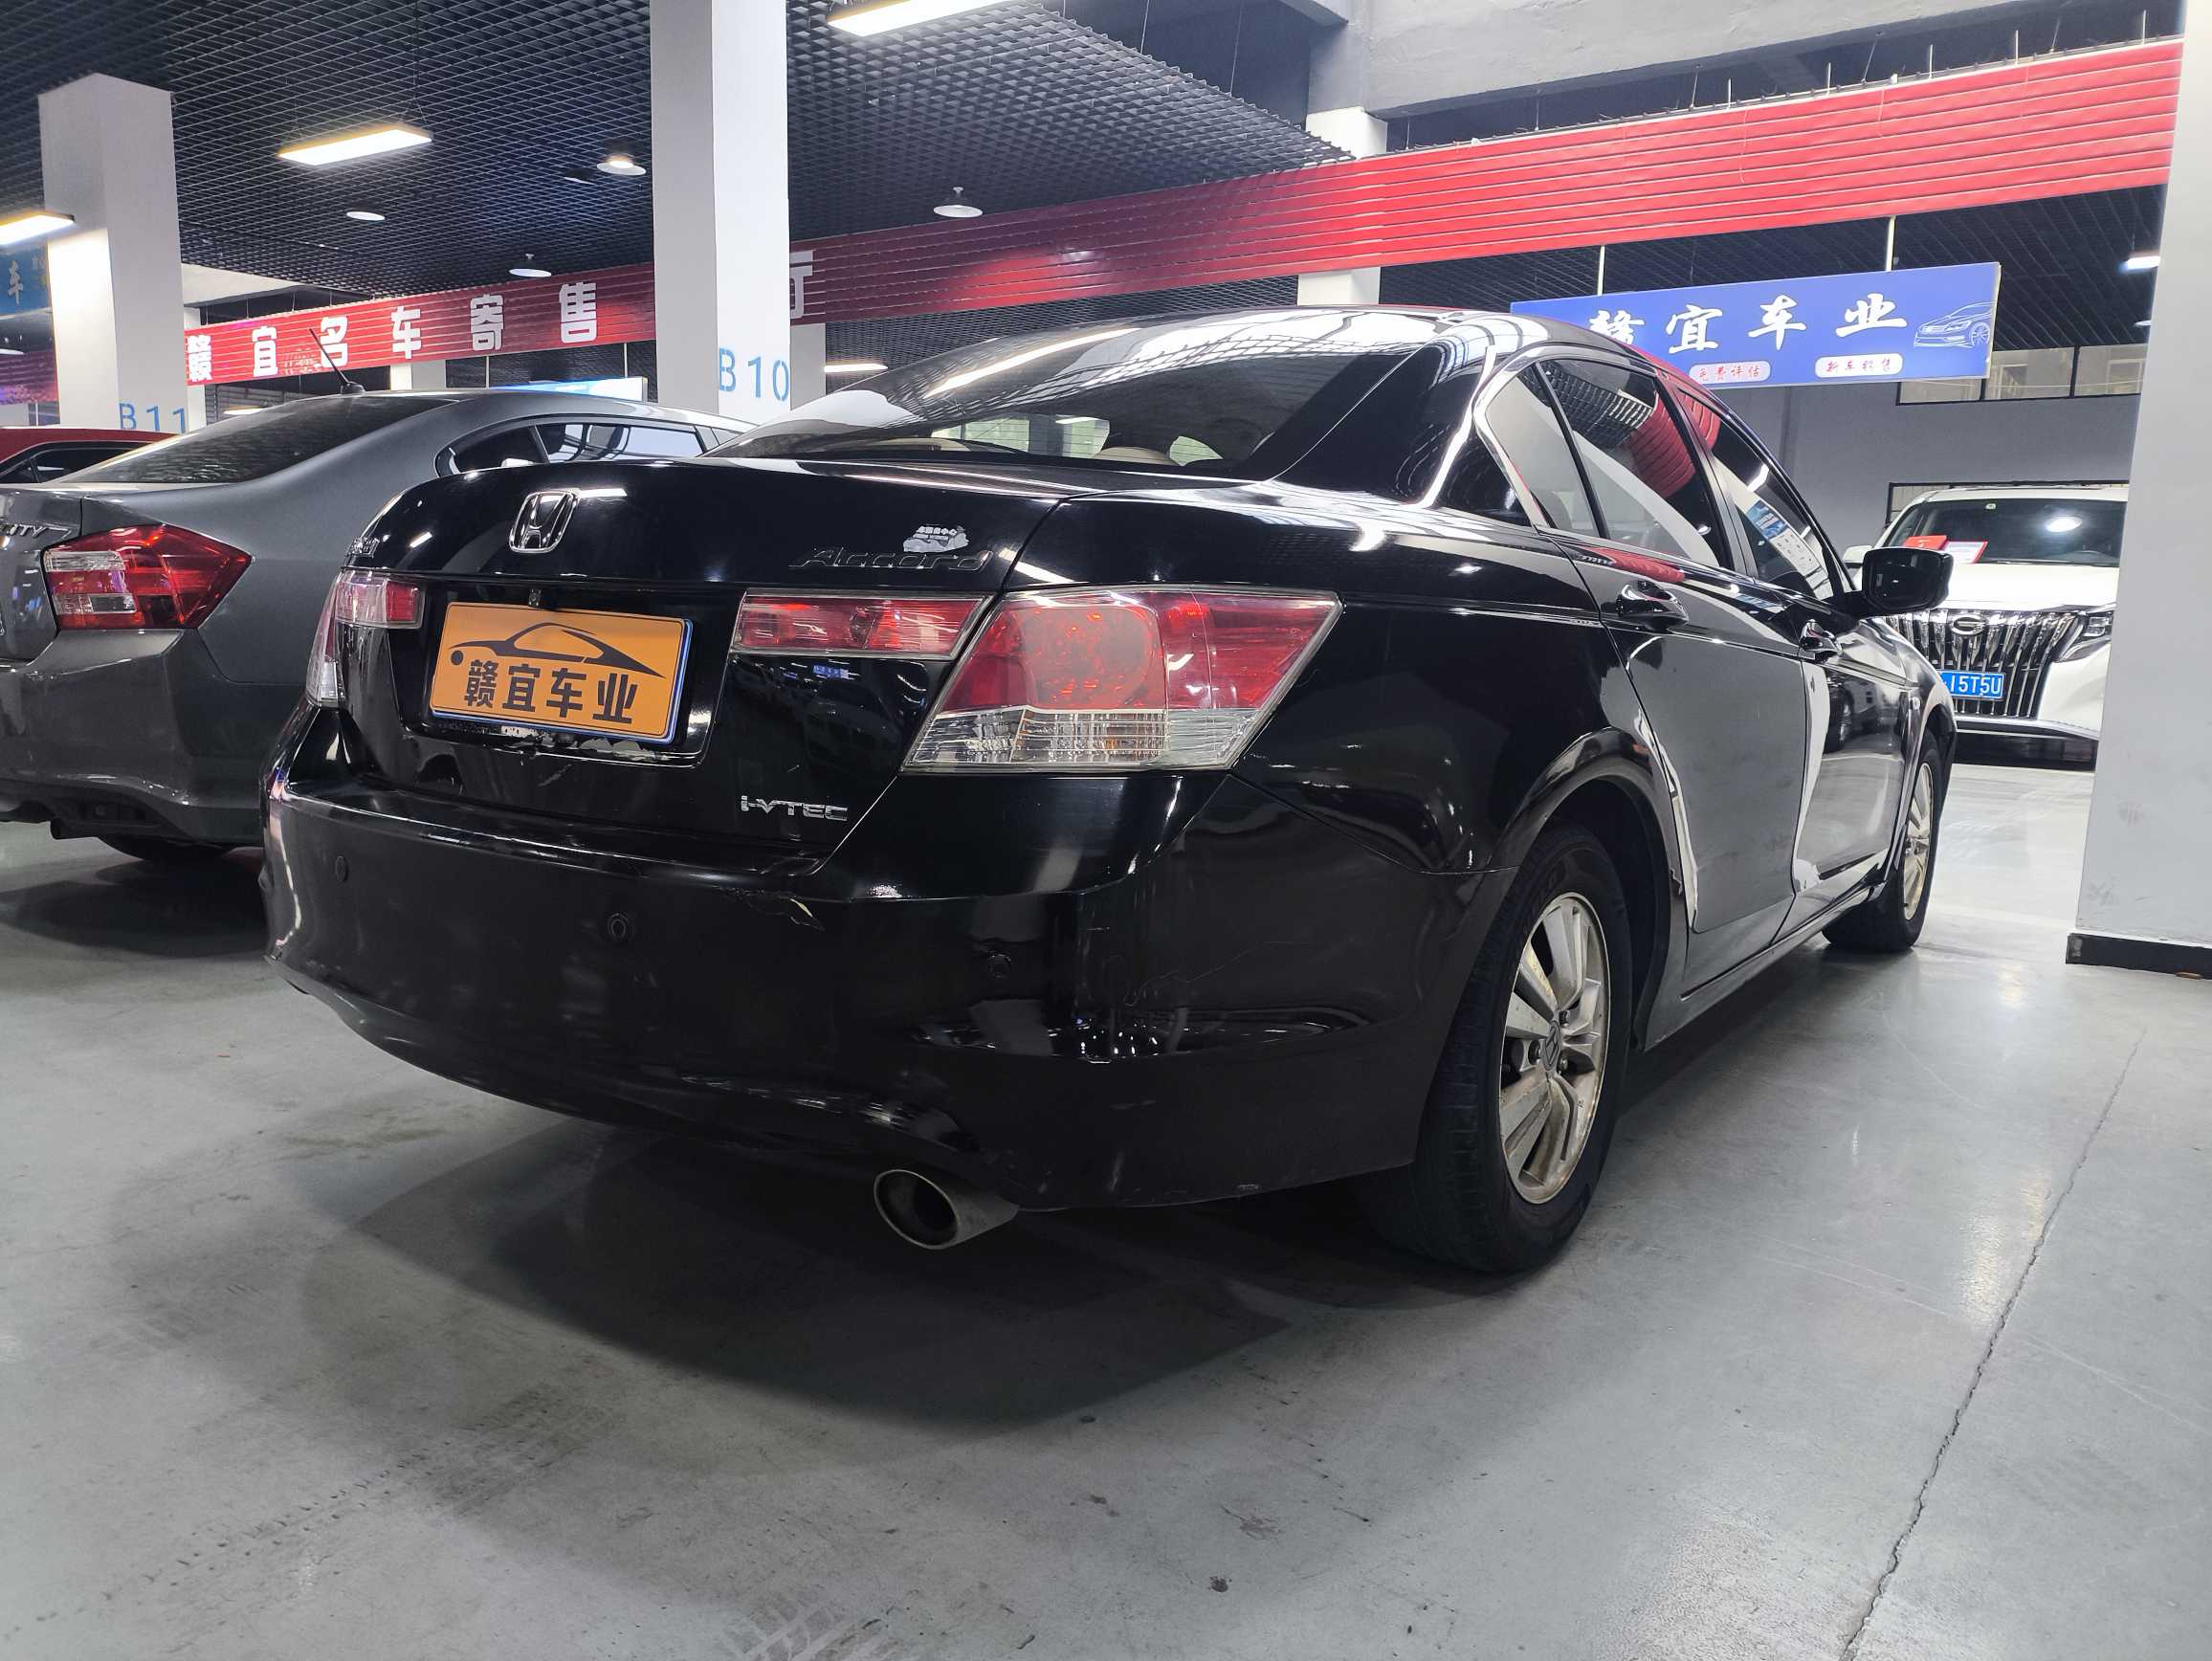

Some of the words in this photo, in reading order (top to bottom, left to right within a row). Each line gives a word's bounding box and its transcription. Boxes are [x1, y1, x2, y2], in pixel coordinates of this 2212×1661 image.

[718, 347, 789, 402] B10
[119, 402, 186, 433] B11
[788, 547, 993, 571] Accord
[464, 659, 639, 724] 赣宜车业
